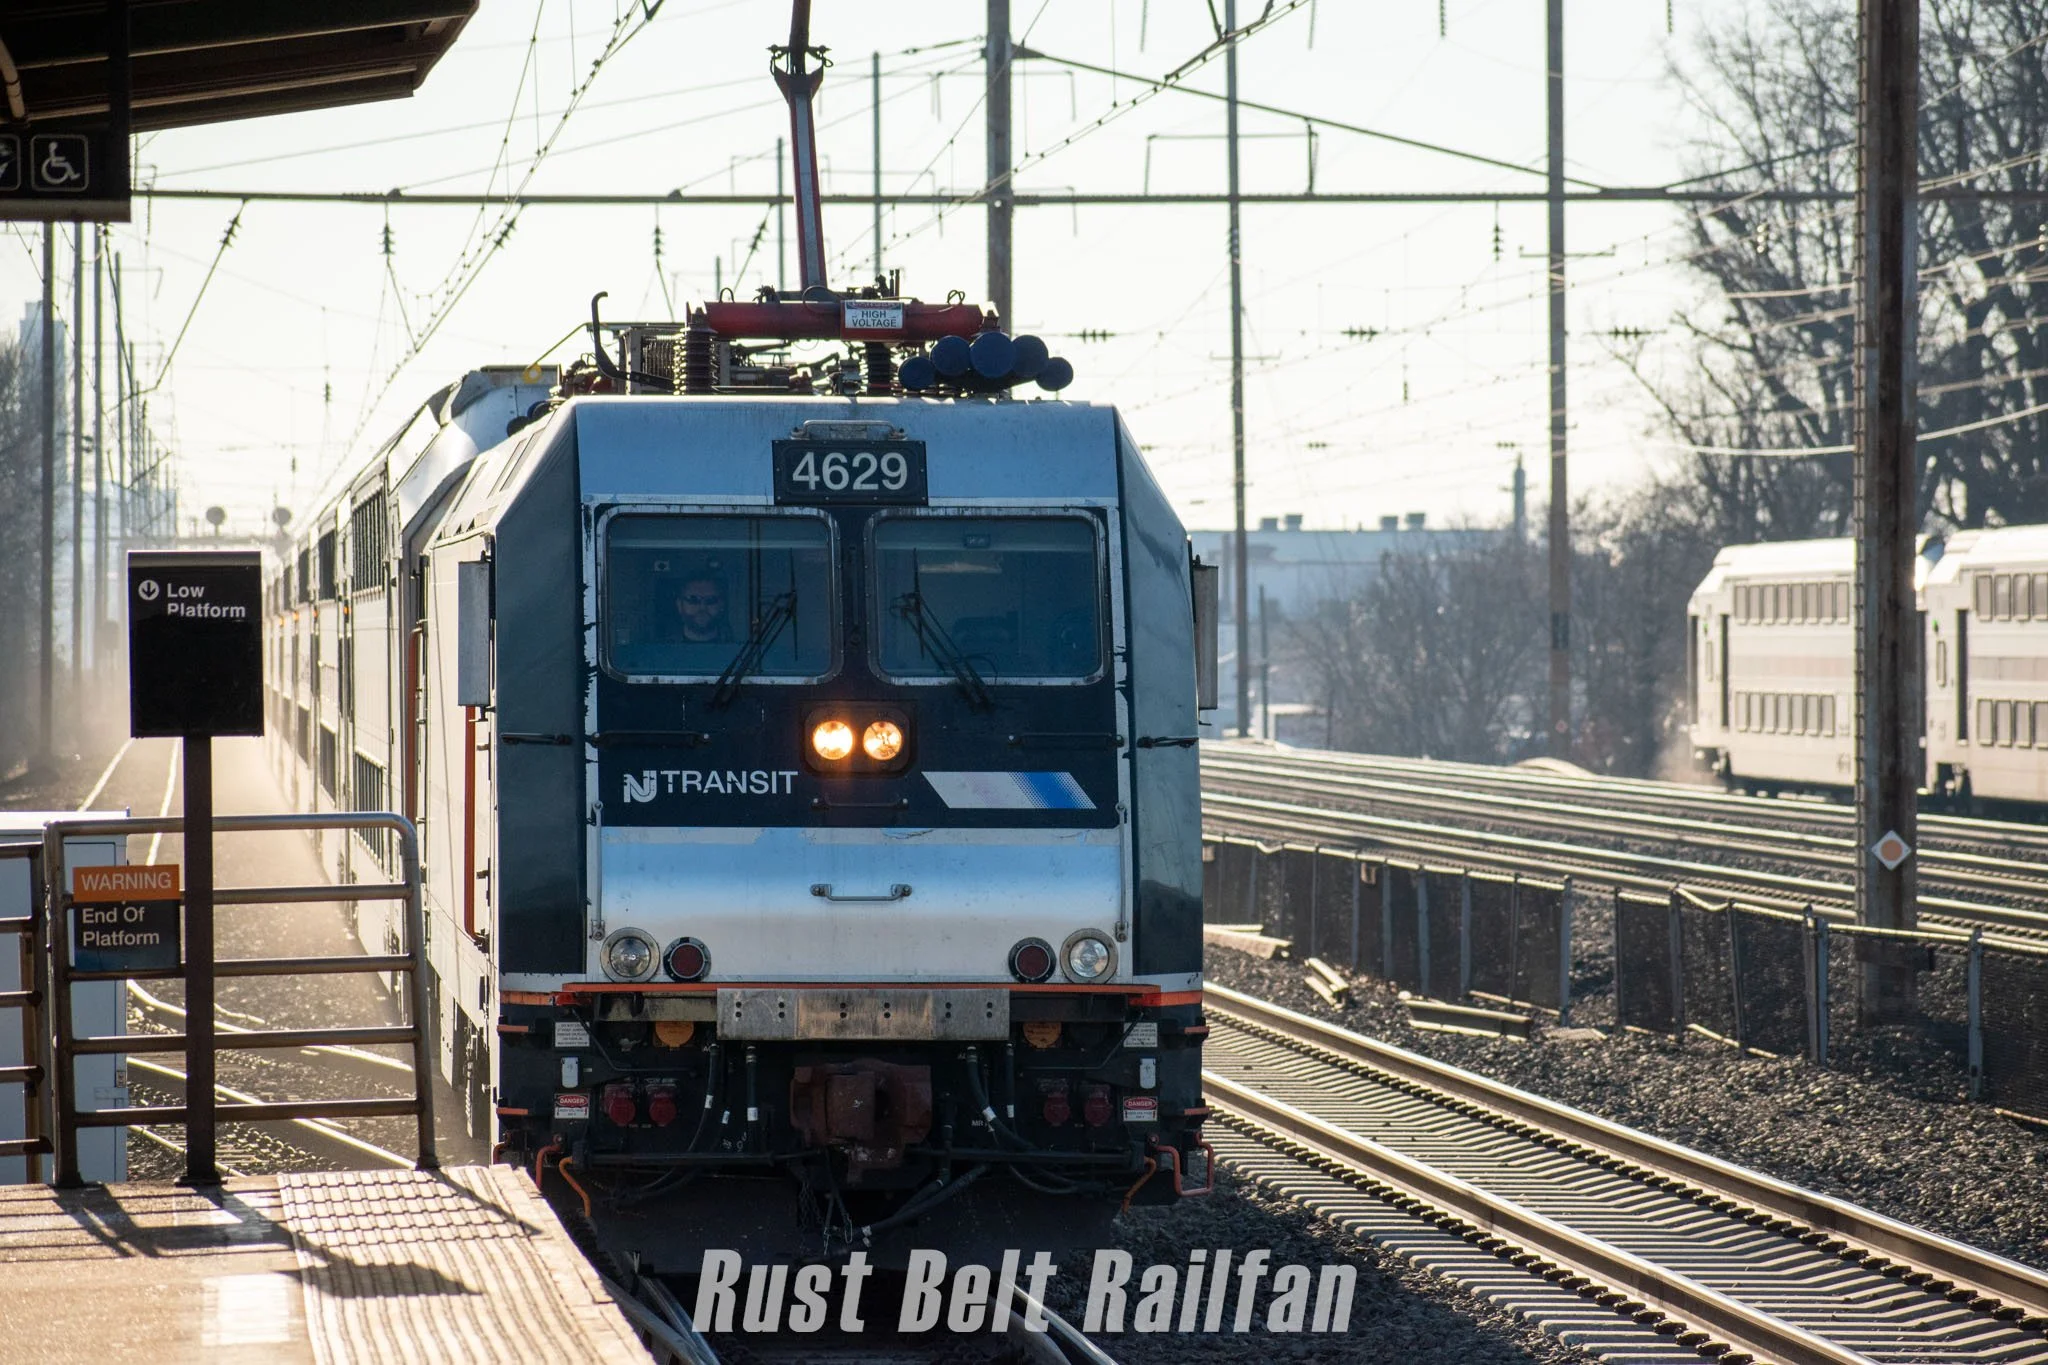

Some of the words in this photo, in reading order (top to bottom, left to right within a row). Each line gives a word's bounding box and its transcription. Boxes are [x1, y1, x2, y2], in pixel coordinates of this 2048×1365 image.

[861, 310, 887, 318] HIGH
[852, 318, 897, 328] VOLTAGE
[792, 451, 908, 490] 4629
[167, 583, 205, 598] Low
[167, 602, 246, 618] Platform
[624, 770, 657, 803] NJ
[660, 770, 799, 795] TRANSIT
[81, 872, 172, 891] WARNING
[82, 907, 118, 924] End
[123, 906, 145, 923] Of
[82, 930, 160, 947] Platform
